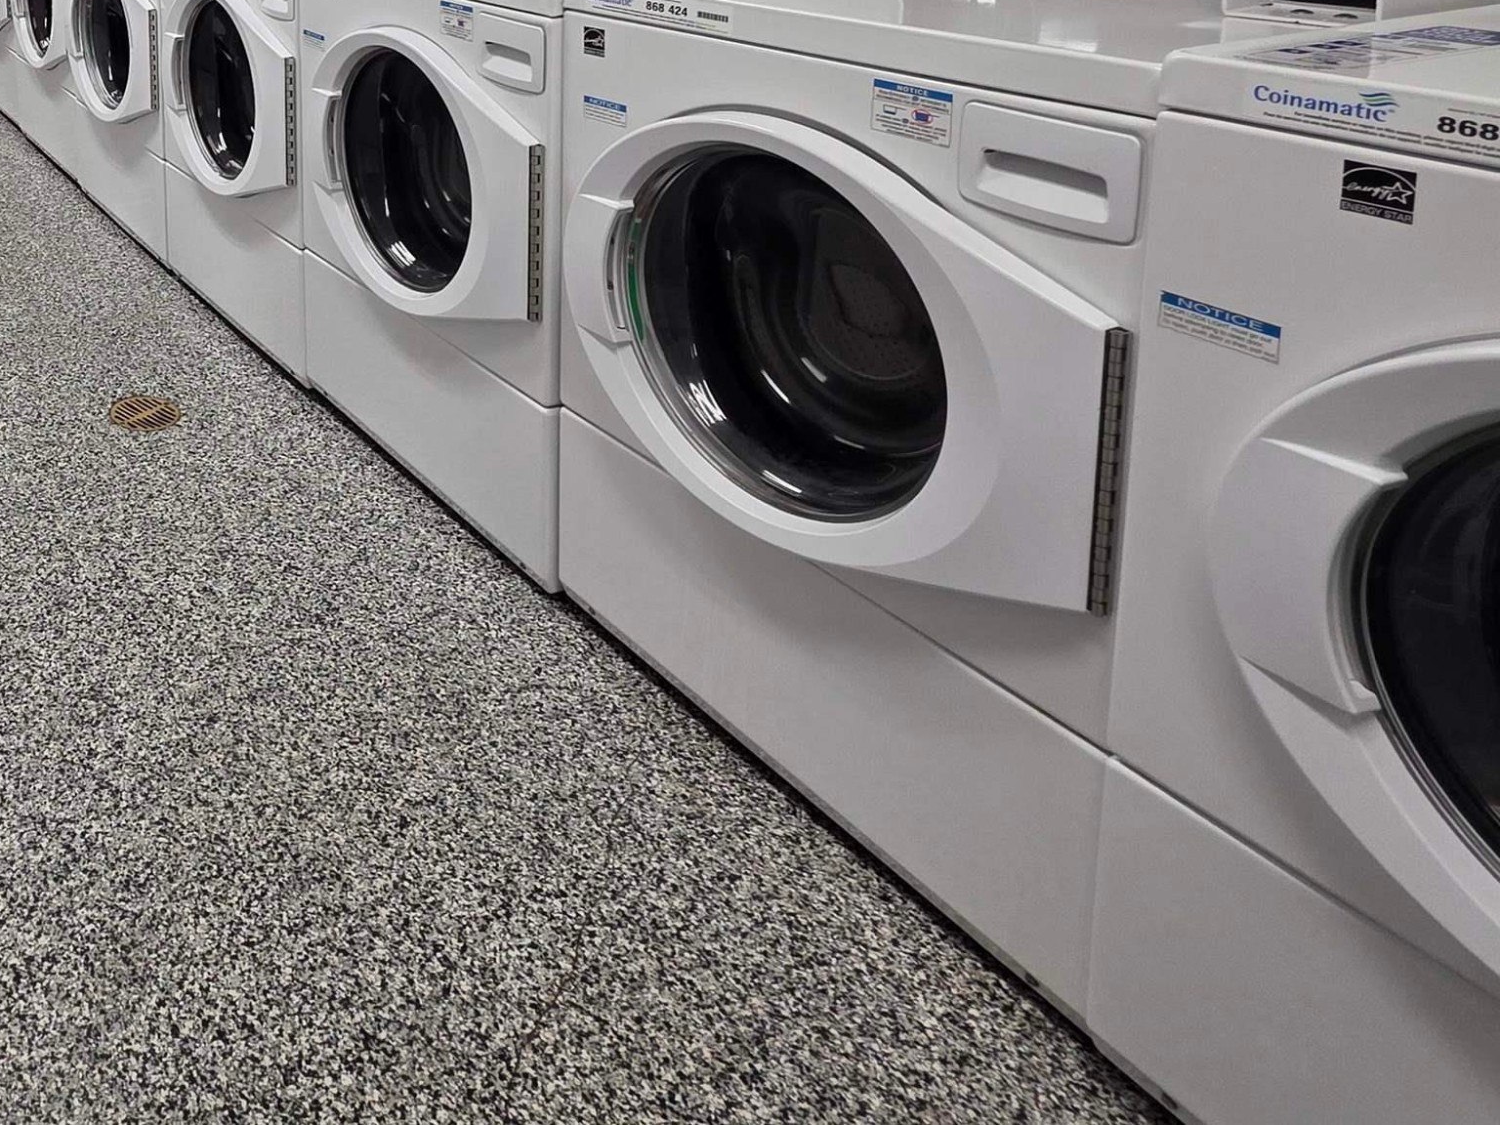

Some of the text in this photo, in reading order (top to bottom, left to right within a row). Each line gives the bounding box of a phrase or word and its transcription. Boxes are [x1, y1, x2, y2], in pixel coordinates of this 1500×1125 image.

[646, 1, 665, 13] 868
[668, 3, 688, 17] 424
[896, 85, 929, 96] NOTICE
[1253, 85, 1387, 122] Coinamatic
[1437, 116, 1499, 141] 868
[1340, 200, 1413, 223] ENERGY STAR
[1177, 297, 1263, 332] NOTICE
